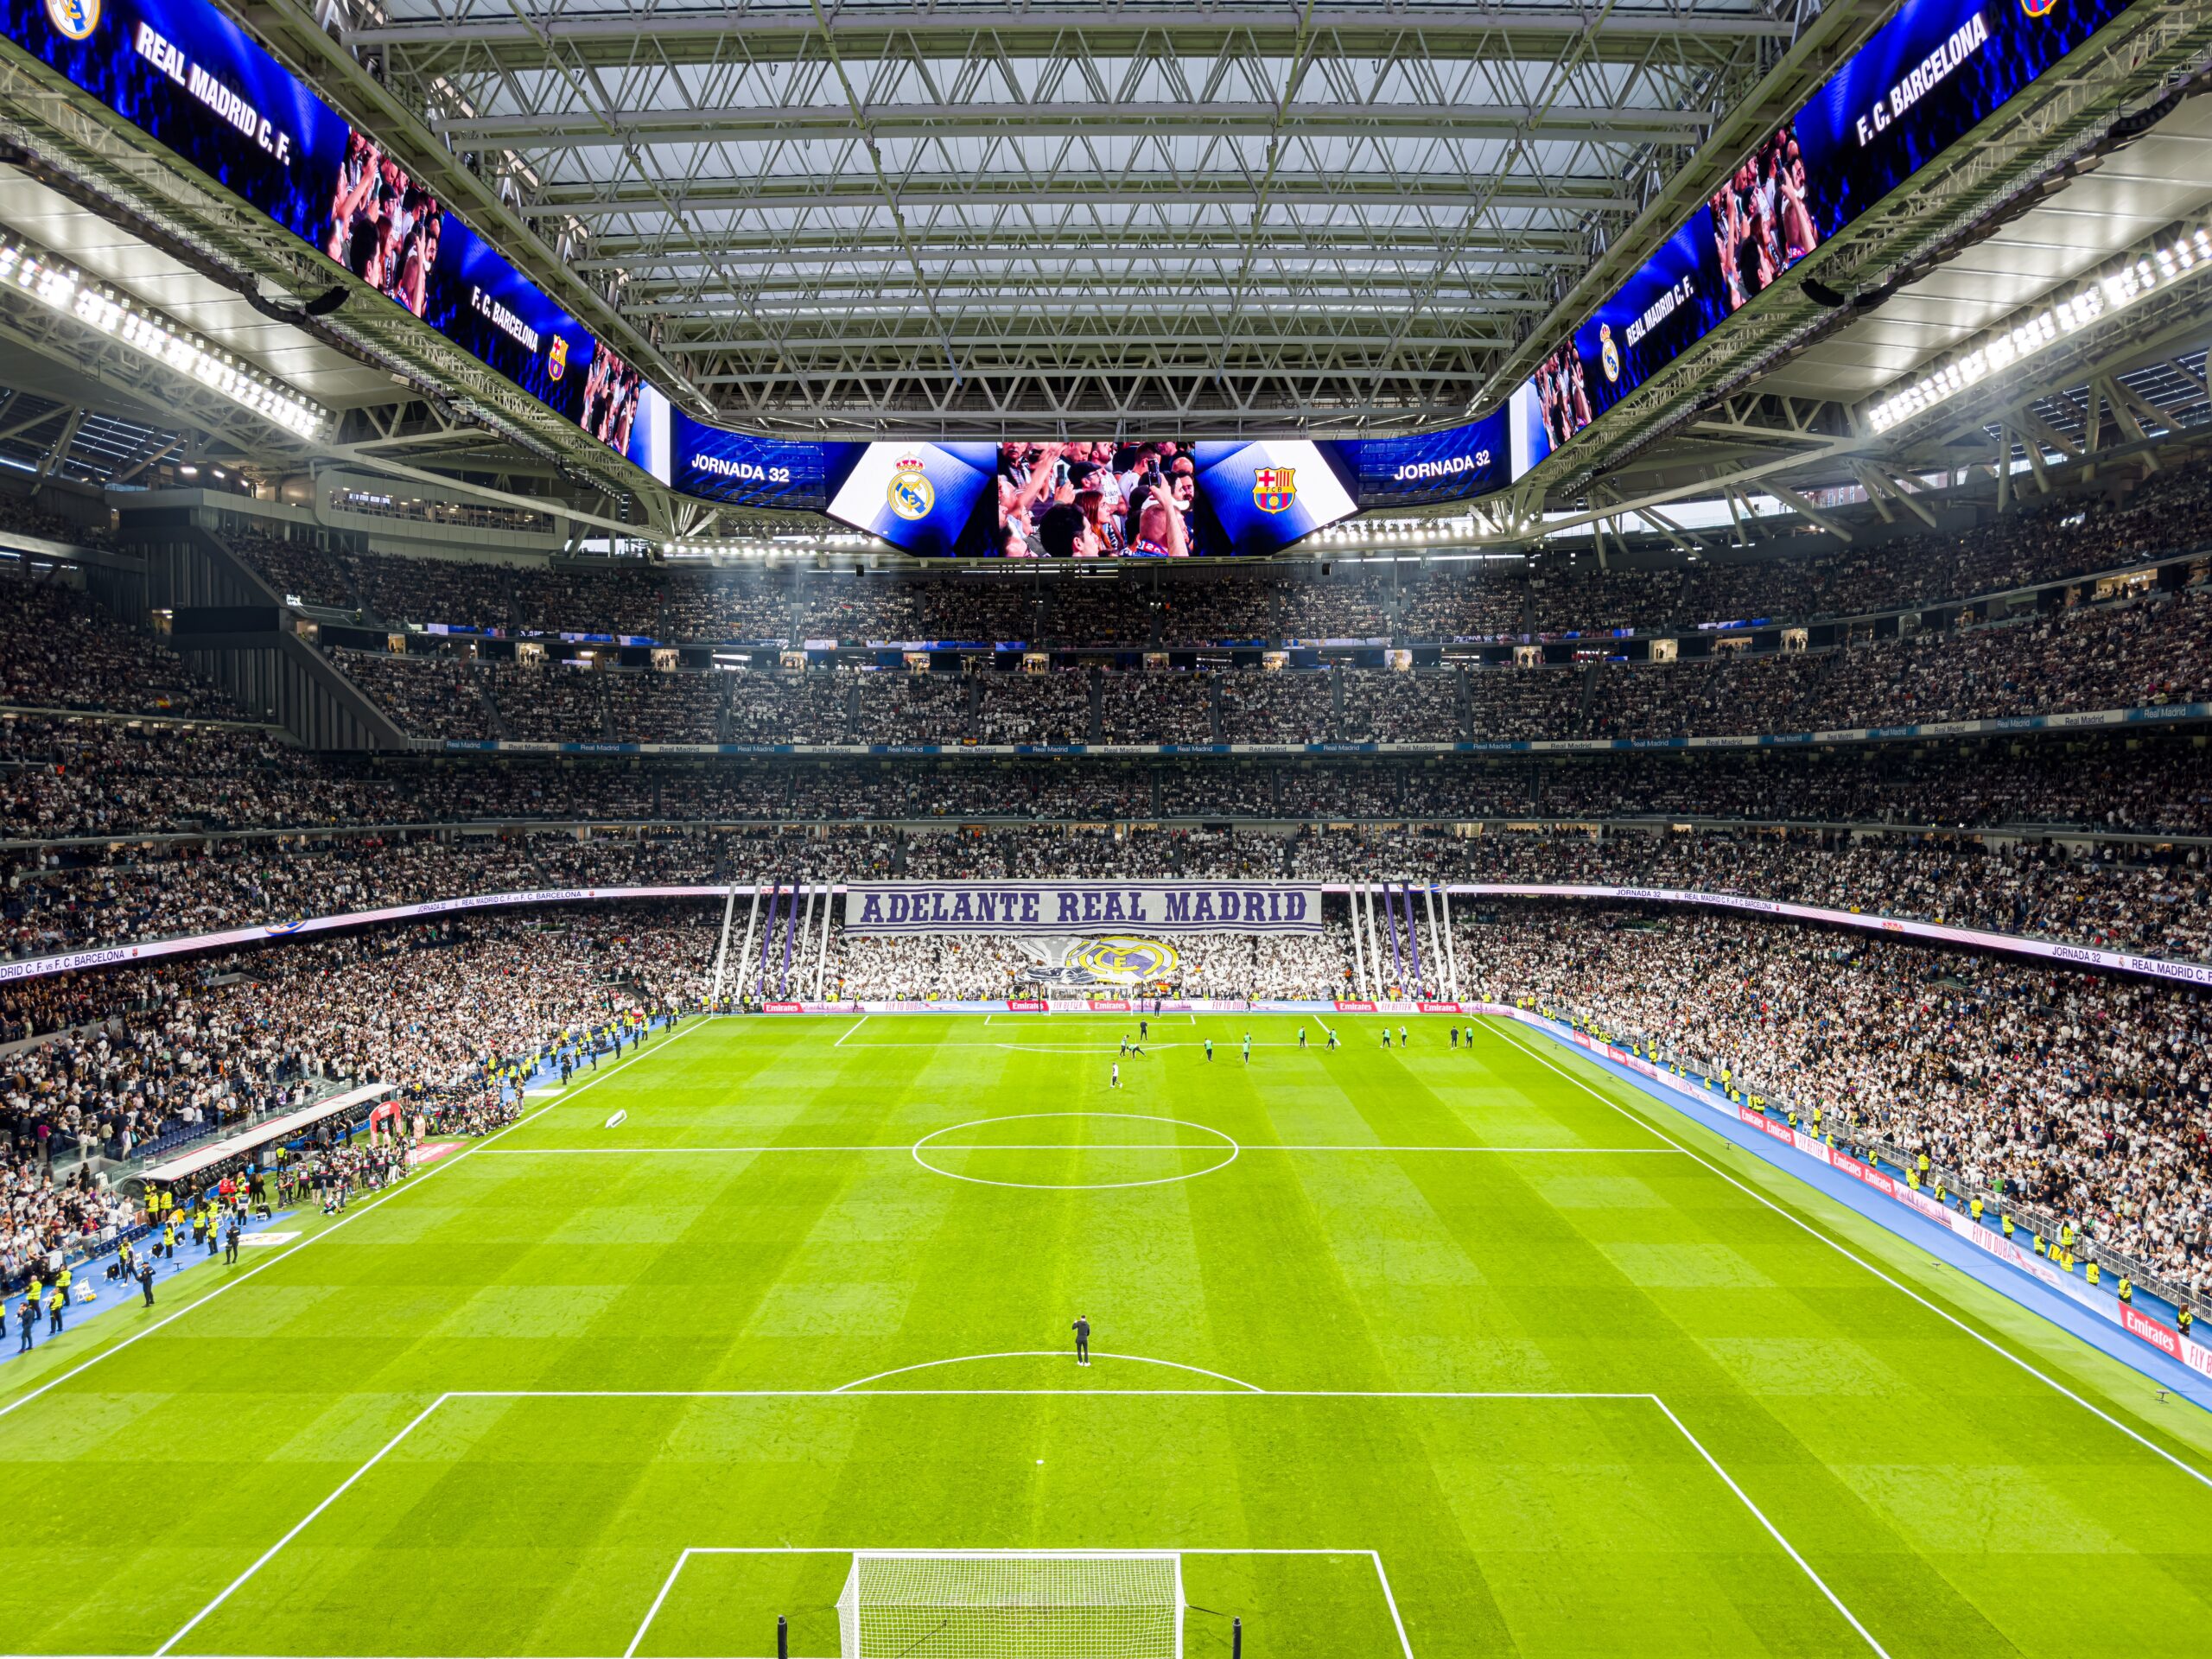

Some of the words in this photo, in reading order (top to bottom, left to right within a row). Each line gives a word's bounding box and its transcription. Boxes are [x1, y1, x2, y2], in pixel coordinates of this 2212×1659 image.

[1856, 115, 1873, 147] F.
[1872, 101, 1891, 132] C.
[1890, 11, 1988, 118] BARCELONA
[136, 21, 185, 86] REAL
[188, 62, 257, 138] MADRID
[258, 118, 273, 153] C.
[276, 132, 289, 166] F.
[472, 285, 480, 310] F.
[482, 294, 491, 318] C.
[492, 302, 538, 353] BARCELONA
[1625, 317, 1646, 347] REAL
[1643, 291, 1675, 332] MADRID
[1674, 284, 1684, 305] C.
[1682, 275, 1694, 298] F.
[691, 454, 765, 480] JORNADA
[768, 467, 790, 482] 32
[1394, 454, 1474, 480] JORNADA
[1476, 449, 1491, 467] 32
[2081, 715, 2104, 724] Madrid
[2161, 708, 2186, 717] Madrid
[536, 891, 582, 900] BARCELONA
[860, 892, 1039, 923] ADELANTE
[1057, 891, 1147, 923] REAL
[1164, 891, 1307, 922] MADRID
[1701, 894, 1720, 903] MADRID
[1745, 900, 1772, 910] BARCELONA
[417, 904, 440, 912] JORNADA
[26, 963, 35, 974] C.
[37, 962, 43, 972] F.
[55, 959, 61, 969] F.
[64, 958, 72, 968] C.
[74, 950, 124, 966] BARCELONA
[2052, 946, 2090, 962] JORNADA
[2092, 953, 2101, 963] 32
[2132, 958, 2155, 972] REAL
[2157, 963, 2194, 979] MADRID
[2196, 969, 2205, 981] C.
[885, 1002, 895, 1011] FLY
[897, 1002, 905, 1011] TO
[1212, 1001, 1223, 1010] FLY
[1224, 1001, 1231, 1010] TO
[1232, 1001, 1246, 1010] DUB
[1741, 1109, 1764, 1128] Emirates
[1766, 1120, 1791, 1142] Emirates
[1833, 1152, 1862, 1178] Emirates
[1865, 1167, 1892, 1192] Emirates
[1973, 1224, 1983, 1244] FLY
[1984, 1230, 1992, 1250] TO
[2126, 1311, 2175, 1352] Emirates
[2190, 1345, 2204, 1369] FLY
